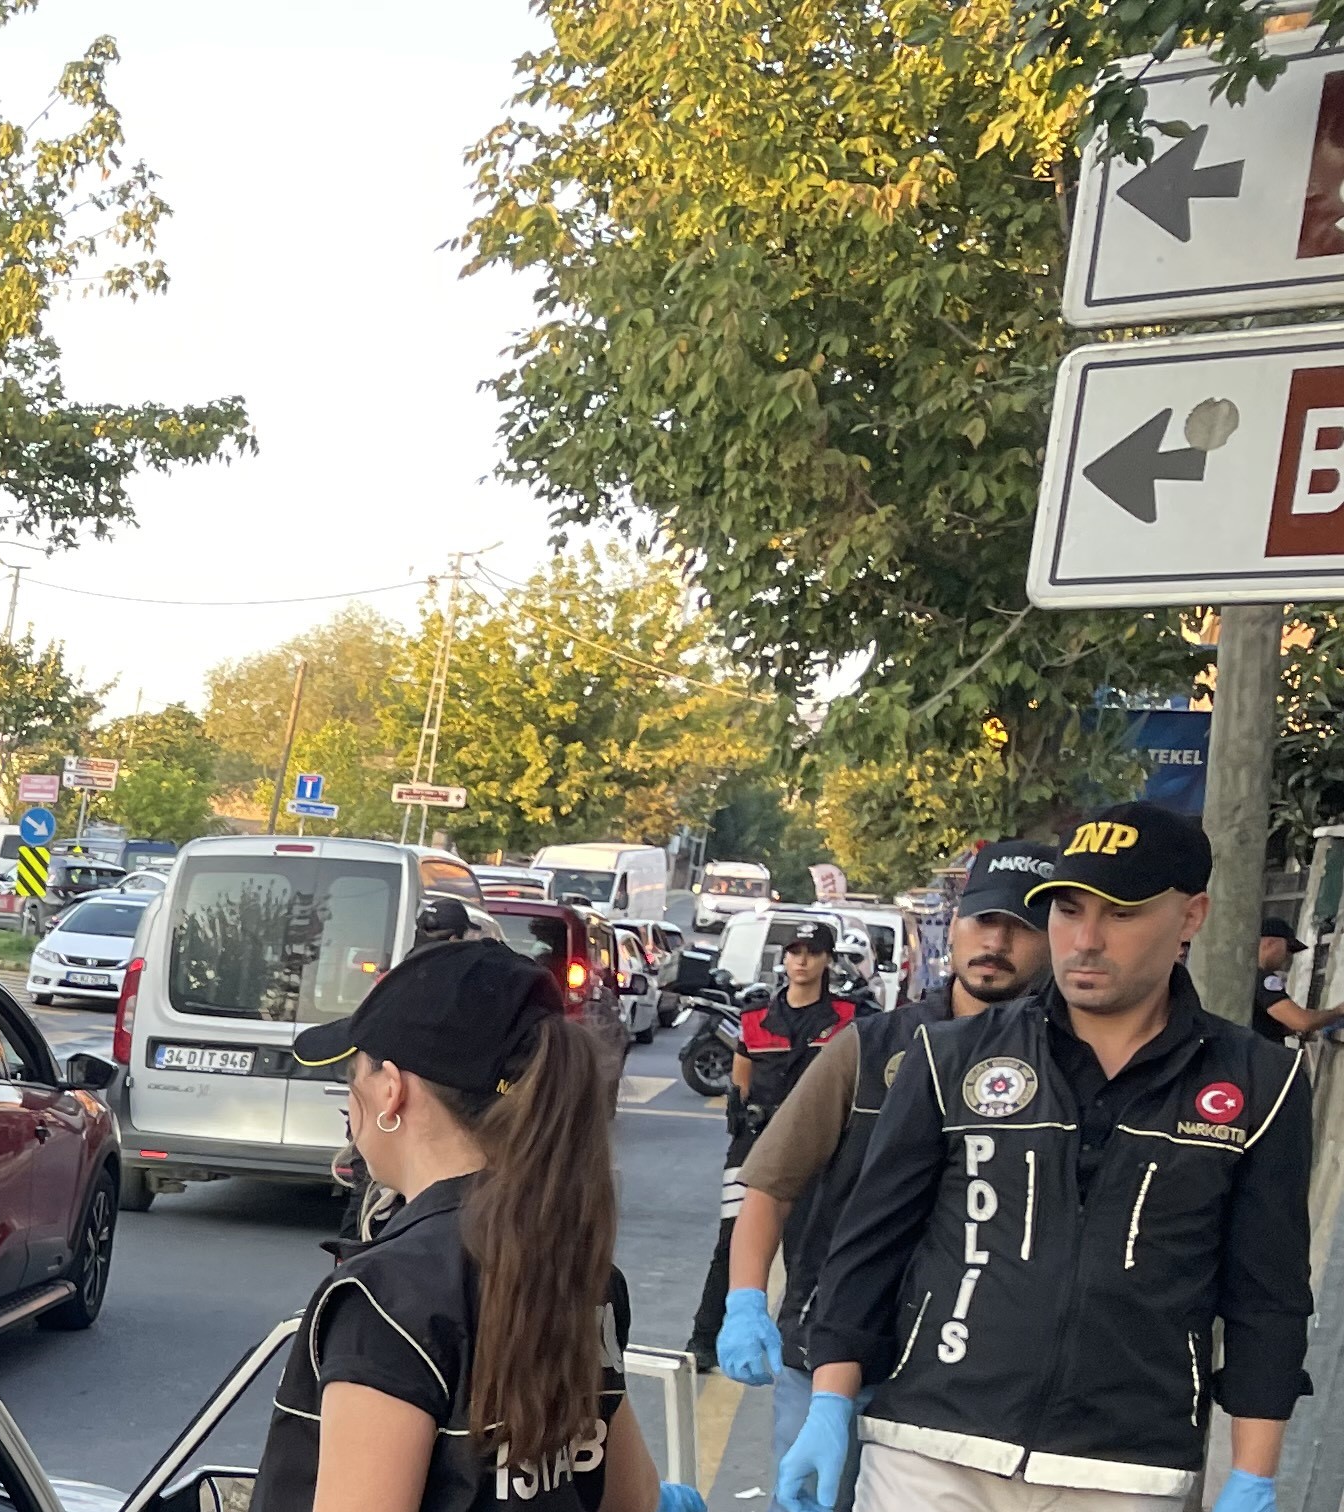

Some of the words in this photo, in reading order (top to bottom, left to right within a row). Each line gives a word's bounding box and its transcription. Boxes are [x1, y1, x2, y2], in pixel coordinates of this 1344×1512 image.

[1148, 748, 1204, 765] TEKEL
[1063, 821, 1139, 856] INP
[165, 1050, 183, 1065] 34
[219, 1053, 249, 1068] 946
